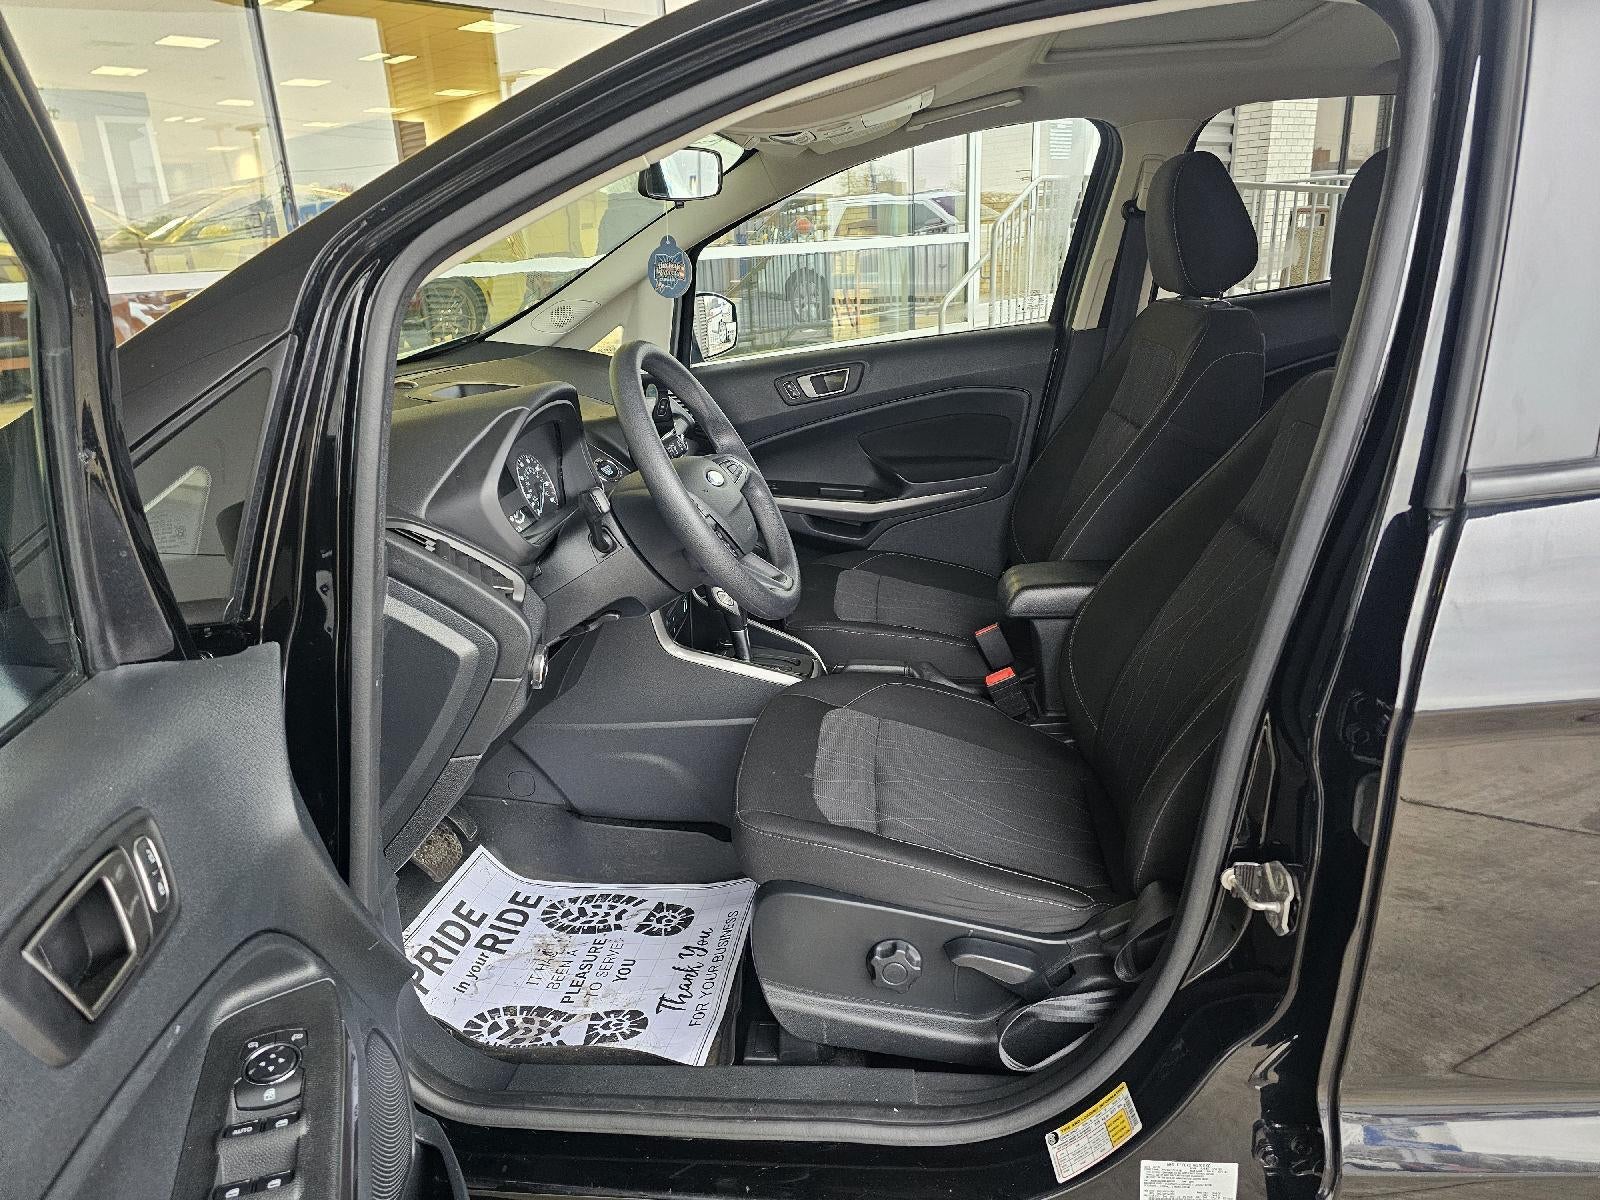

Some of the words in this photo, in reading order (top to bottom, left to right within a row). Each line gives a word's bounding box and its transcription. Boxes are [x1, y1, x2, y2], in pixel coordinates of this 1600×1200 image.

[473, 890, 544, 955] RIDE
[411, 900, 488, 996] PRIDE
[678, 927, 714, 960] You
[465, 951, 490, 981] your
[526, 973, 542, 986] IT
[546, 960, 573, 990] BEEN
[567, 949, 579, 957] A
[560, 938, 608, 1004] PLEASURE
[612, 958, 636, 983] YOU
[688, 1002, 709, 1027] FOR
[699, 964, 721, 999] YOUR
[711, 910, 739, 963] BUSINESS
[452, 981, 471, 994] in
[584, 982, 603, 998] TO
[655, 961, 705, 1015] Thank
[232, 1126, 253, 1135] AUTO
